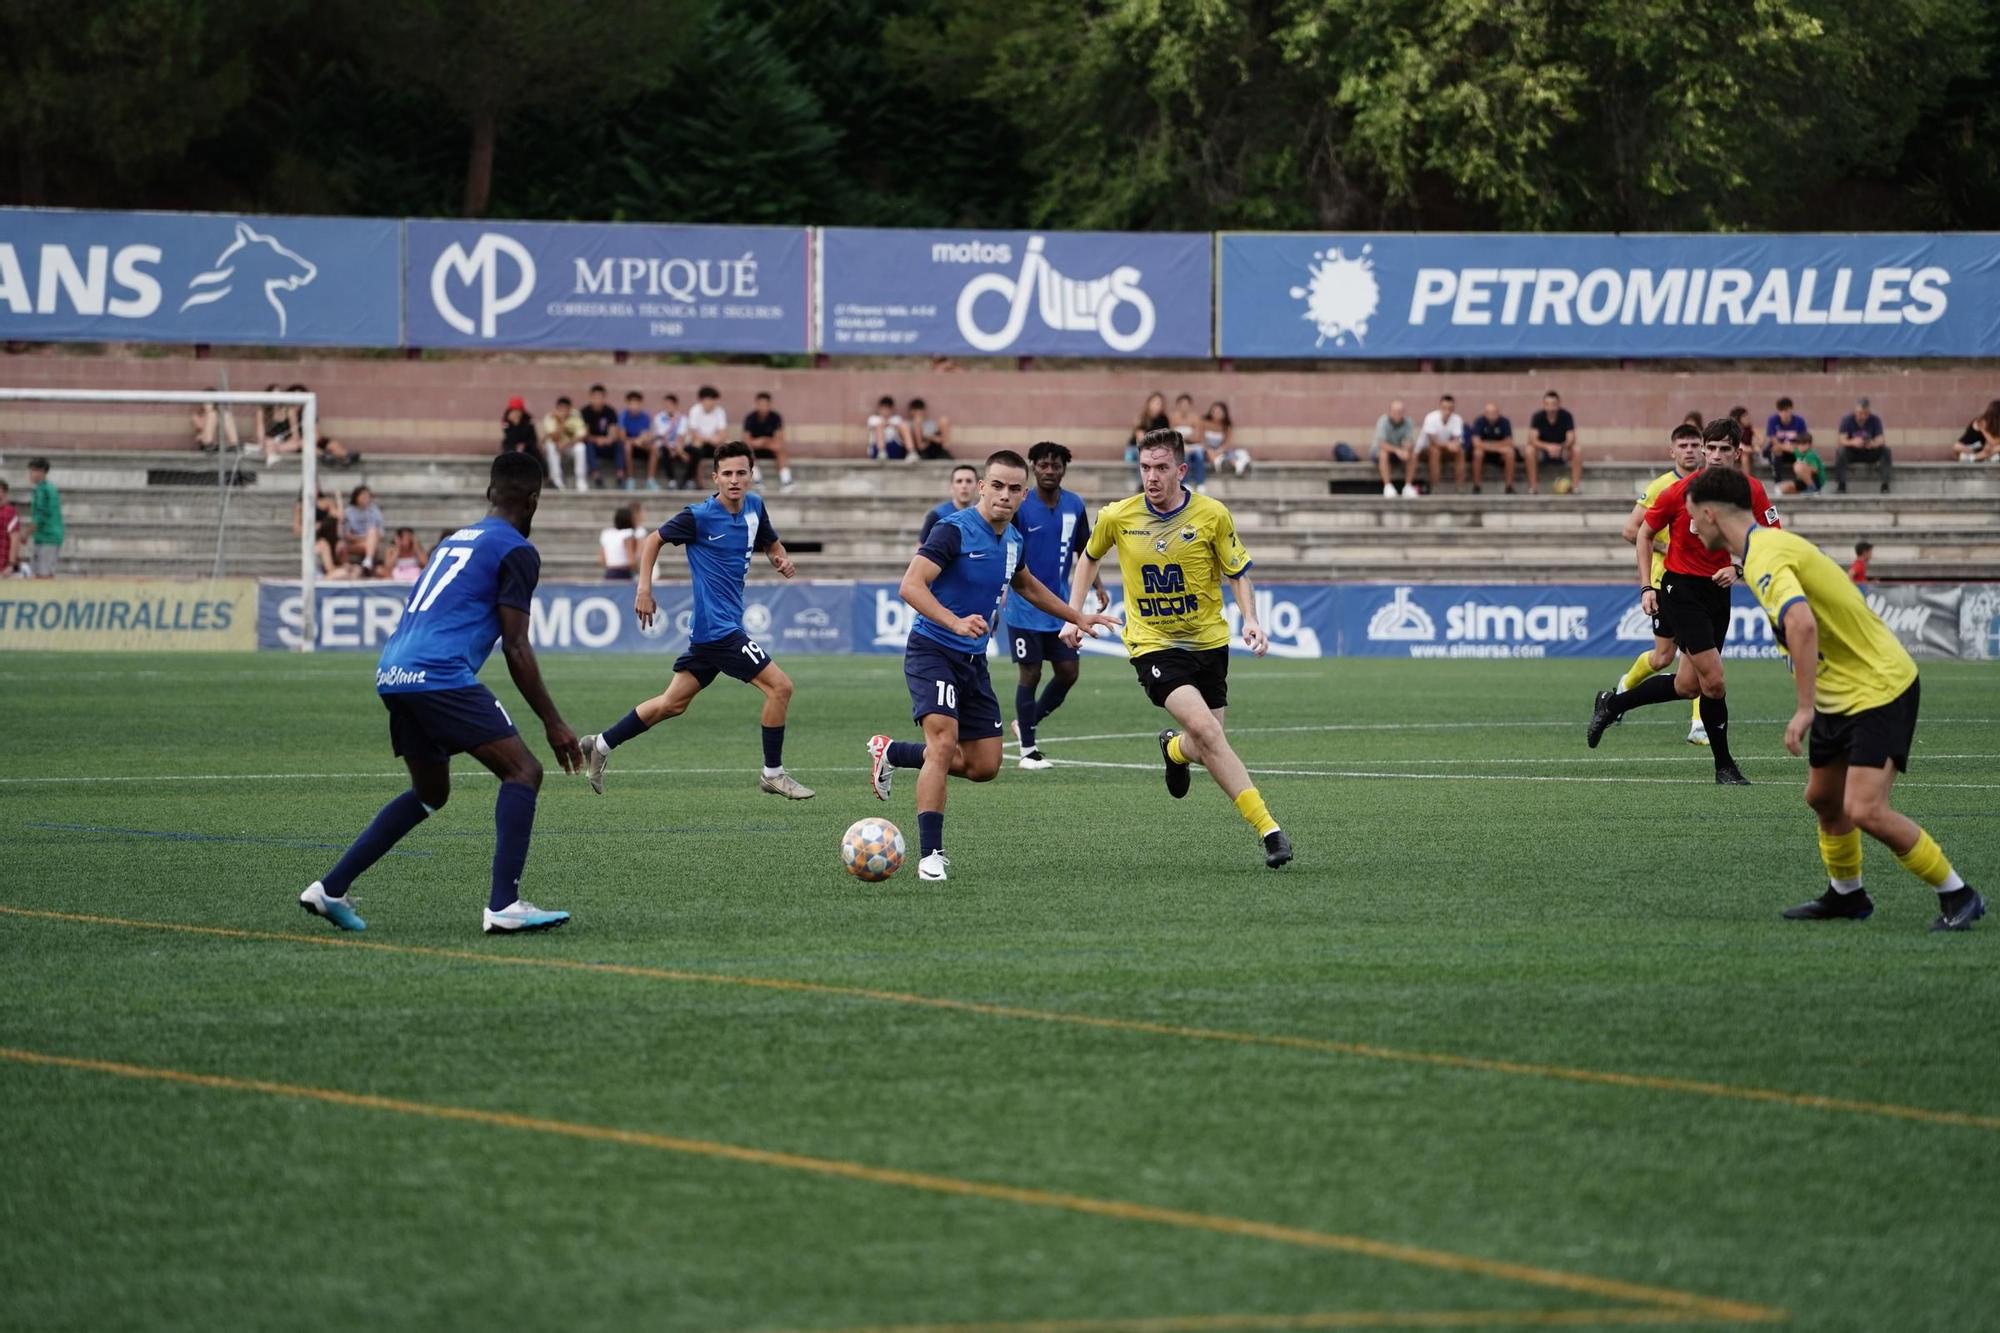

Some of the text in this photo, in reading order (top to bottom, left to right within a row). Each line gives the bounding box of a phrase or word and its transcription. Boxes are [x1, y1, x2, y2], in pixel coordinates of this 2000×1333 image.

[932, 241, 1012, 263] motos
[1409, 267, 1951, 326] PETROMIRALLES
[408, 547, 474, 613] 17
[1654, 619, 1660, 630] 9
[742, 640, 765, 664] 19
[1015, 637, 1027, 659] 8
[1410, 642, 1546, 658] www.simarsa.com
[1151, 665, 1161, 679] 6
[936, 680, 956, 709] 10
